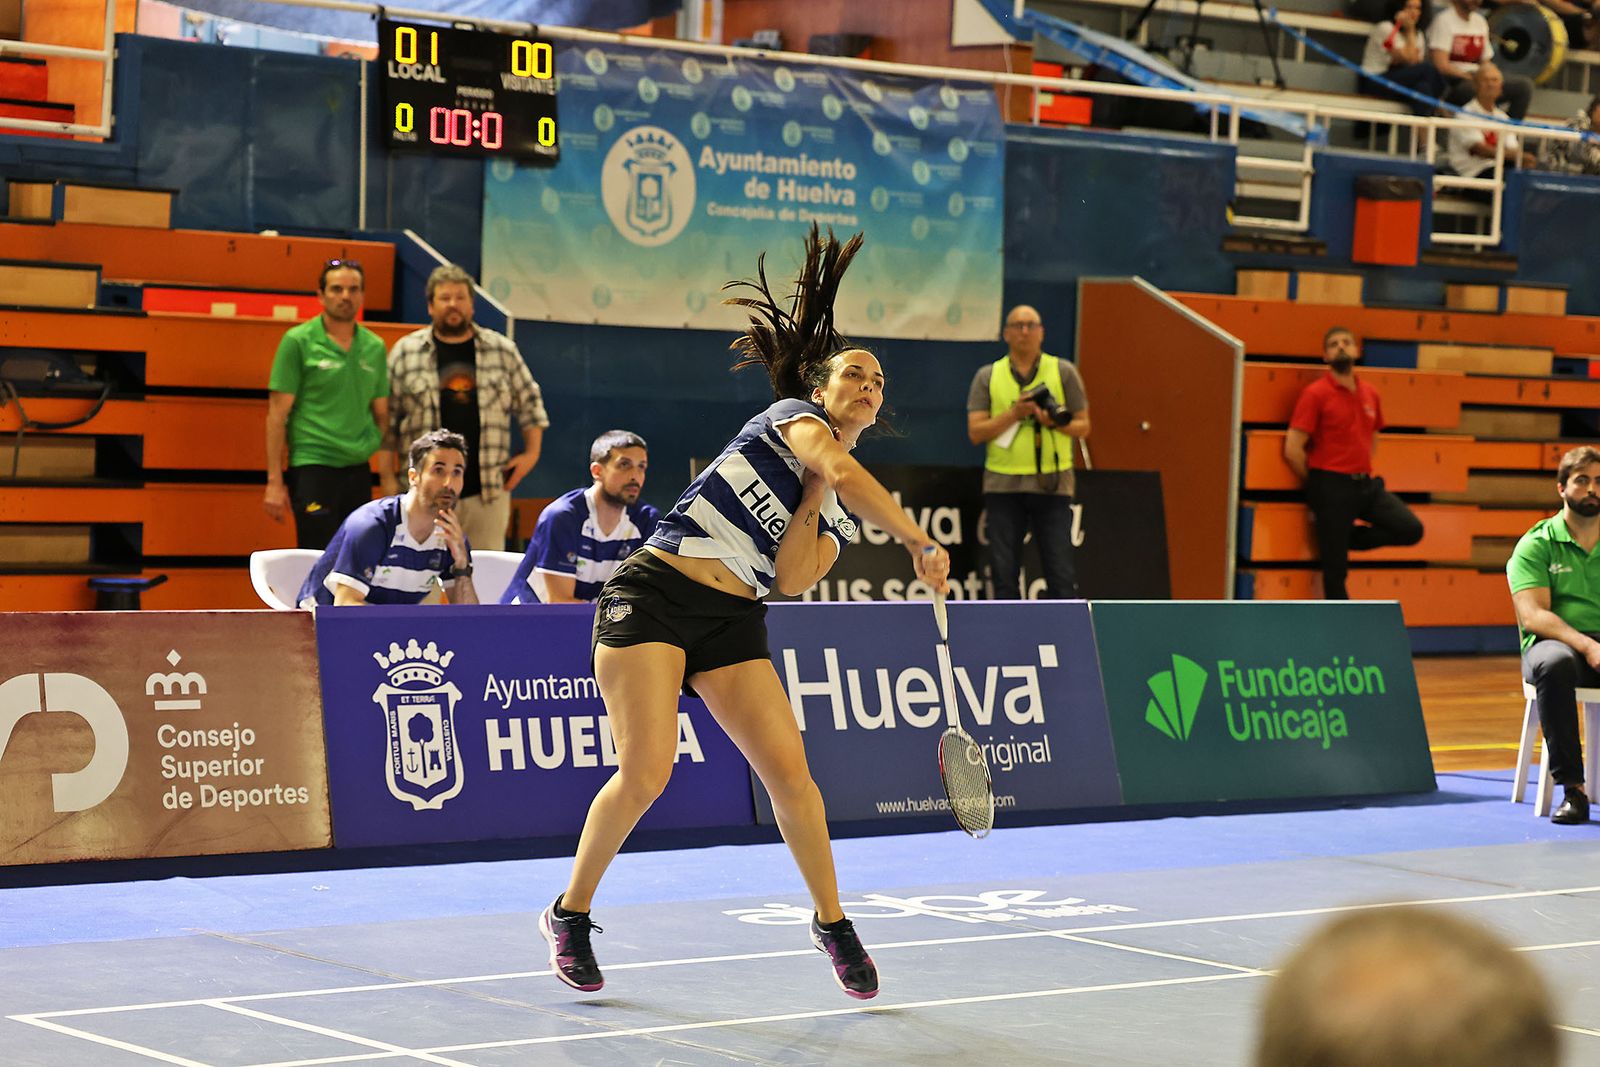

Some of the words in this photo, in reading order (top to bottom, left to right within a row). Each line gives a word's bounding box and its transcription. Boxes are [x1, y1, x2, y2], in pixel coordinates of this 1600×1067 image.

[395, 26, 438, 66] 01
[511, 39, 553, 80] 00
[387, 61, 447, 84] LOCAL
[500, 72, 556, 96] VISITANTE
[395, 102, 414, 133] 0
[538, 116, 556, 147] 0
[699, 145, 857, 181] Ayuntamiento
[744, 176, 771, 200] de
[777, 178, 856, 207] Huelva
[778, 207, 797, 222] de
[483, 672, 604, 710] Ayuntam
[782, 643, 1045, 732] Huelva
[1217, 656, 1386, 699] Fundación
[157, 722, 256, 752] Consejo
[1224, 699, 1348, 750] Unicaja
[485, 711, 705, 771] HUELA
[161, 753, 264, 783] Superior
[162, 786, 193, 810] de
[200, 783, 309, 813] Deportes
